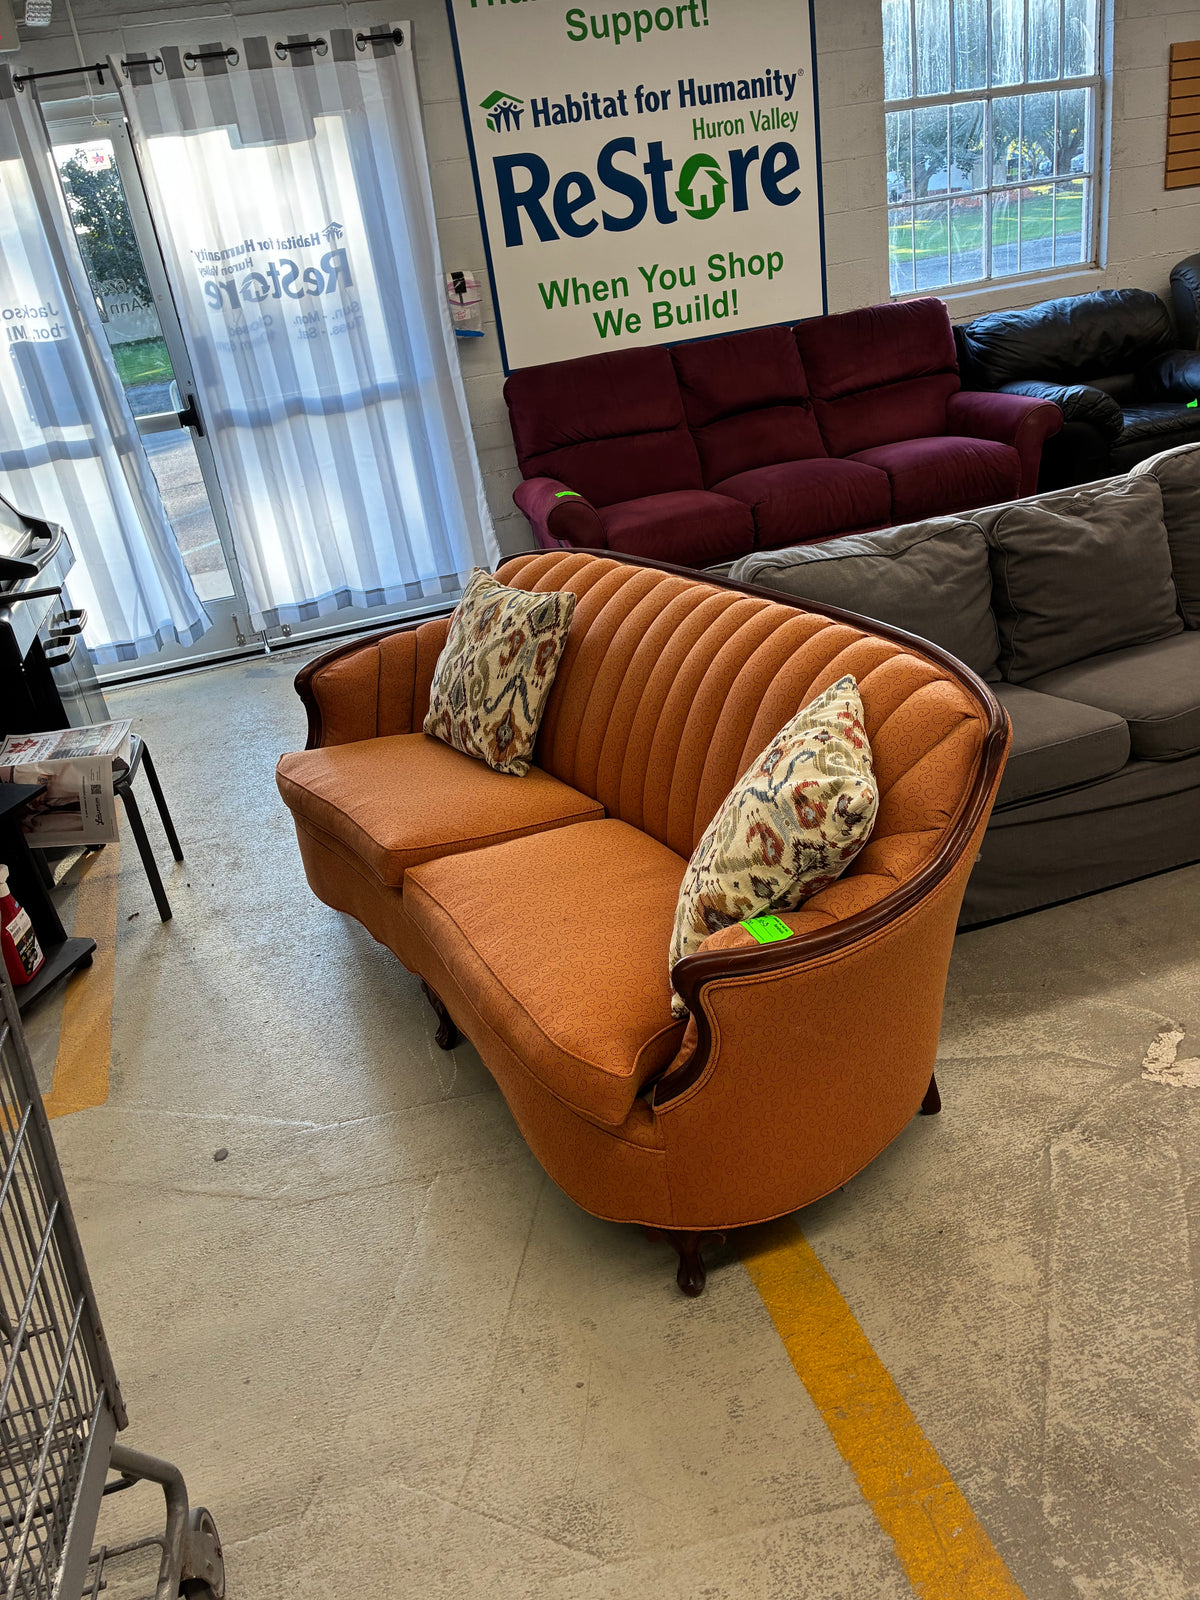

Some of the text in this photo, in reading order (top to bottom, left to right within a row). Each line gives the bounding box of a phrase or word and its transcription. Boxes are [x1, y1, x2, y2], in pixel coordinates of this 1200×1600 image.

[565, 0, 709, 45] Support!
[530, 90, 629, 128] Habitat
[634, 84, 673, 115] for
[692, 107, 799, 141] Huron Valley
[492, 136, 802, 248] ReStore
[538, 251, 784, 310] When You Shop
[593, 288, 739, 339] We Build!
